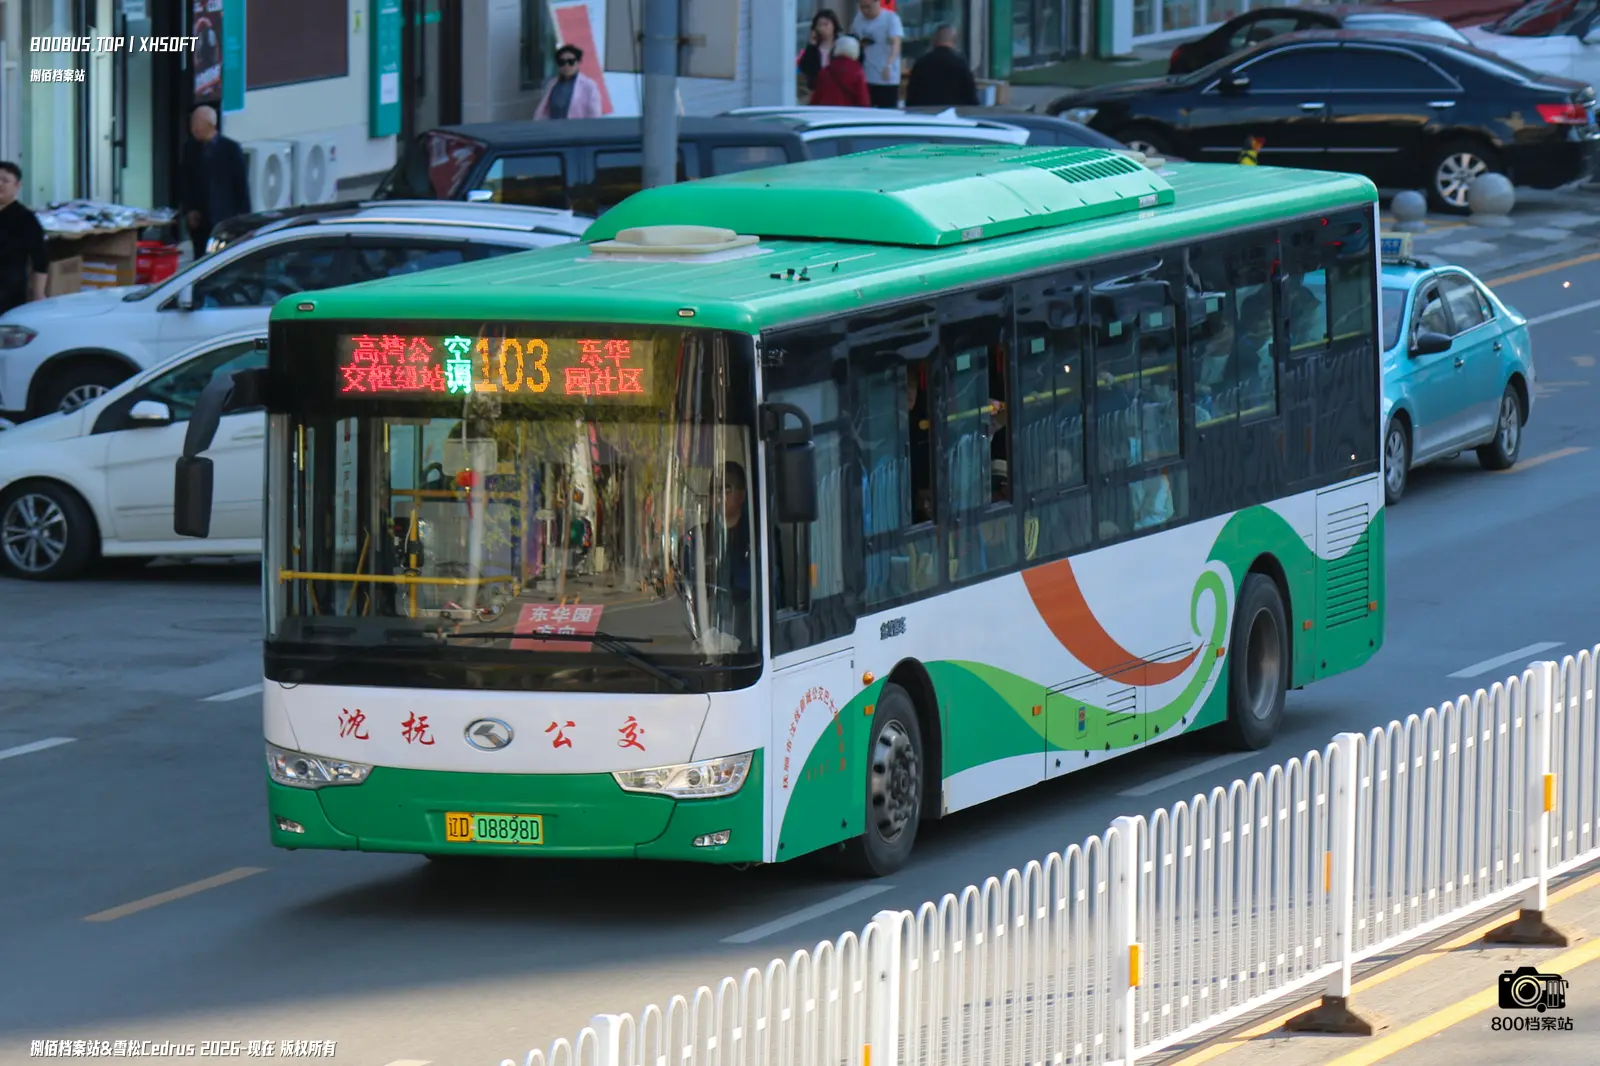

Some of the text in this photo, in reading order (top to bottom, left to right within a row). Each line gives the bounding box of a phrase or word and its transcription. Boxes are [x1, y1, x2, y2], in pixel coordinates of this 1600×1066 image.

[444, 335, 472, 394] 空调
[474, 338, 550, 393] 103
[577, 339, 631, 367] 东华
[340, 363, 446, 392] 交枢纽站
[565, 366, 644, 395] 园社区
[529, 606, 593, 623] 东华园
[449, 817, 540, 840] 辽D 08898D
